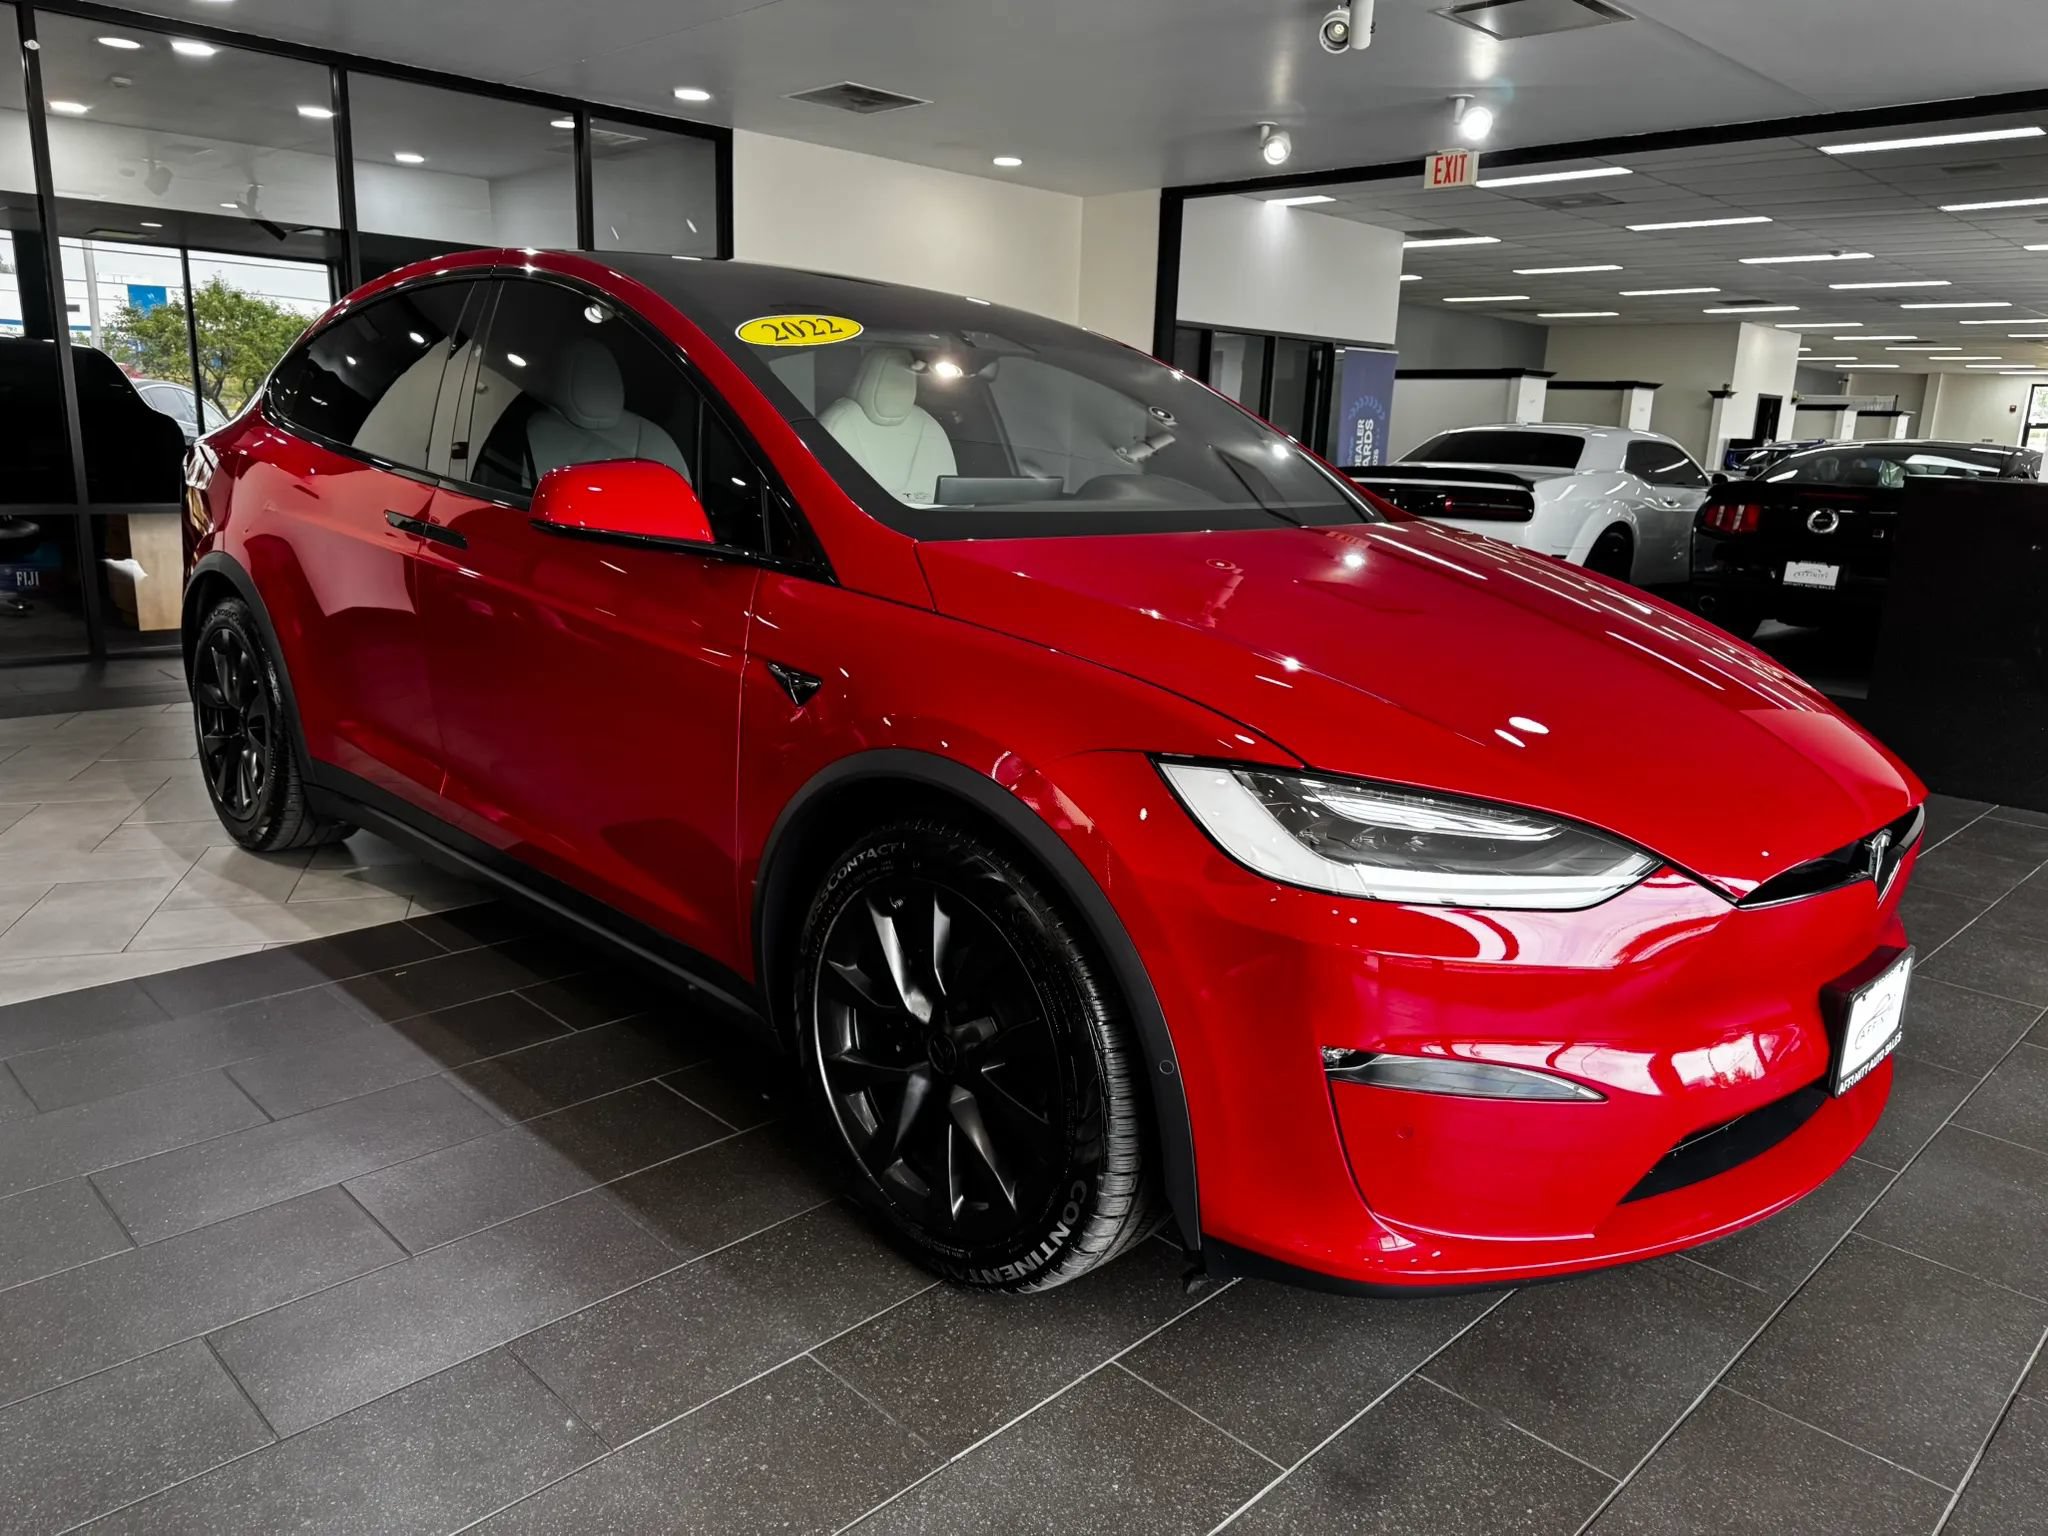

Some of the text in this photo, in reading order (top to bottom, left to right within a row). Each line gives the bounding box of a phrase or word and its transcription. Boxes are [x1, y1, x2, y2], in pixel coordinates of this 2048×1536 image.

[1433, 154, 1468, 184] EXIT
[761, 318, 843, 341] 2022
[16, 571, 39, 586] FIJI
[1838, 1031, 1902, 1095] AFFINITY AUTO SALES
